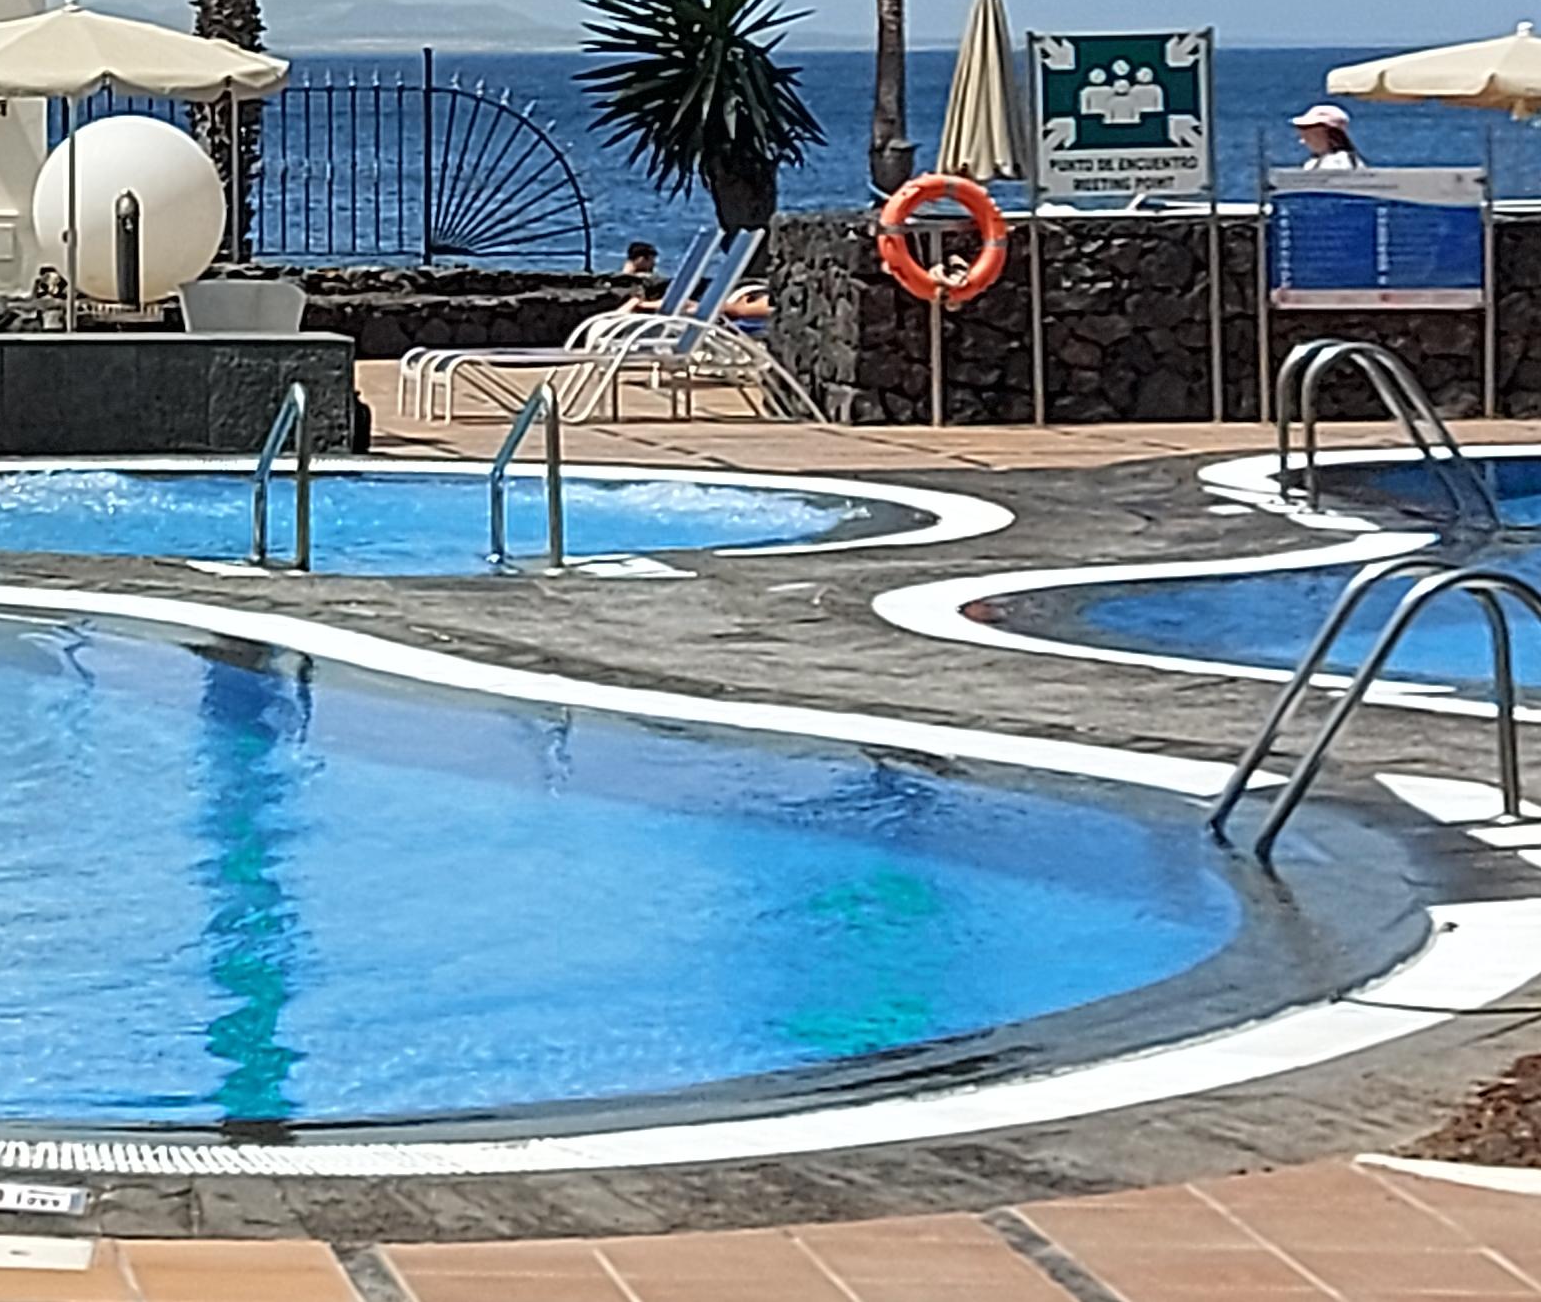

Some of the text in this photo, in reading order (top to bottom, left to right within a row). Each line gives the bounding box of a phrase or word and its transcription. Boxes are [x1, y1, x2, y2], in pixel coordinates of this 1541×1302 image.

[1049, 155, 1198, 172] PUNTO DE ENCUENTRO
[1073, 175, 1175, 191] MEETING POINT
